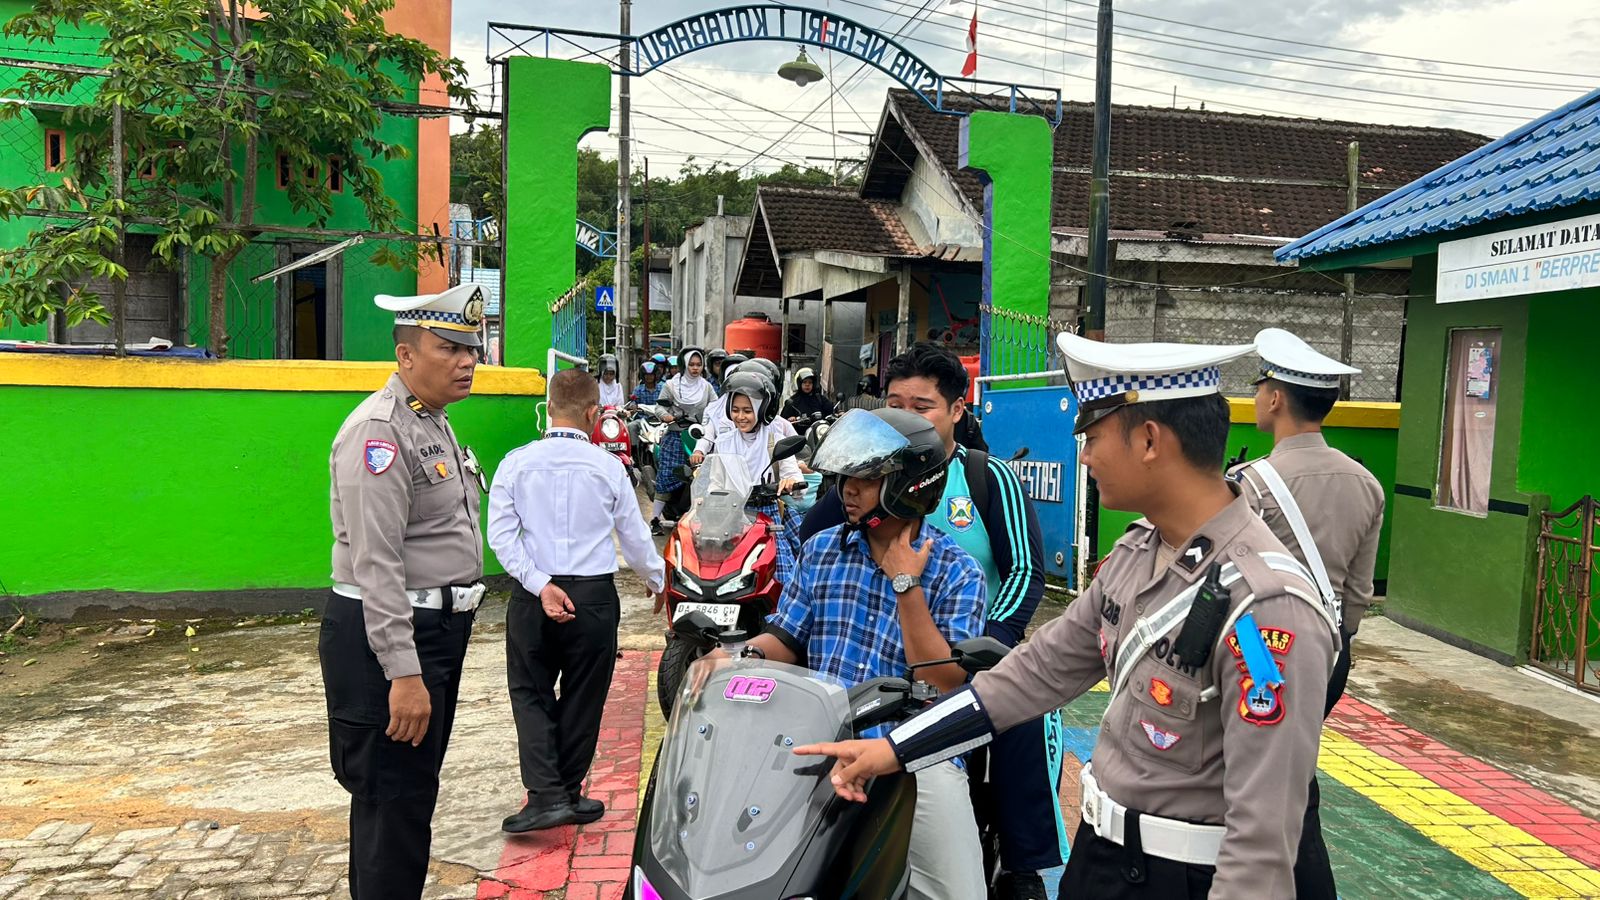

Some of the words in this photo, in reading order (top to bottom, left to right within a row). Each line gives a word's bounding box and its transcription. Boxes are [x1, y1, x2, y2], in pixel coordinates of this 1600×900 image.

[1490, 231, 1557, 257] SELAMAT
[1465, 273, 1477, 289] DI
[1480, 266, 1519, 287] SMAN
[1523, 265, 1530, 282] 1
[908, 470, 945, 493] evolution
[678, 604, 690, 614] DA
[696, 604, 719, 614] 5846
[1229, 629, 1290, 646] PRES
